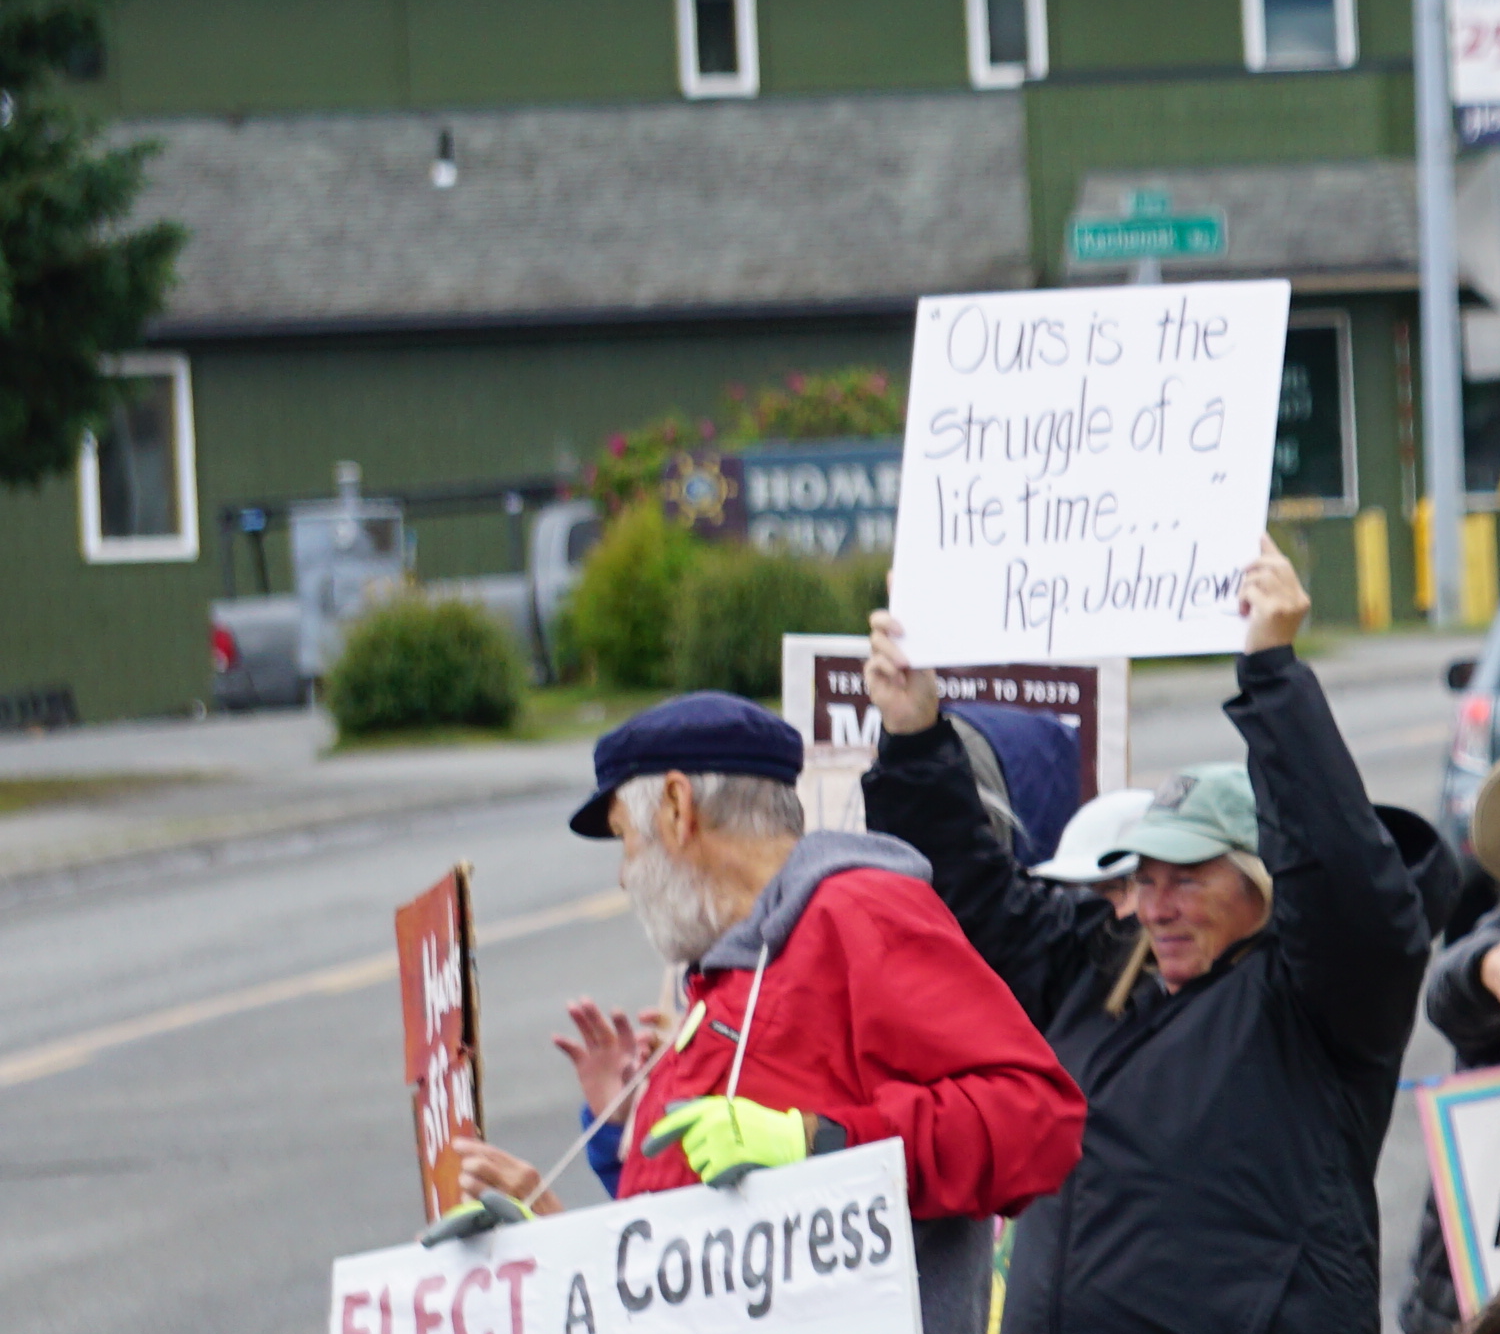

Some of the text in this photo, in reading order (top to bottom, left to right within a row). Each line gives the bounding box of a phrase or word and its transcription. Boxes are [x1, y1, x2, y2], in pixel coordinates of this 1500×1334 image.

[1086, 310, 1124, 366] is
[1156, 296, 1237, 364] the
[925, 375, 1114, 477] struggle
[1130, 375, 1184, 455] of
[1188, 397, 1226, 454] a
[1003, 558, 1070, 656] Rep.
[1083, 544, 1178, 614] John
[828, 671, 869, 695] TEX
[993, 678, 1018, 702] TO
[615, 1193, 893, 1321] Congress
